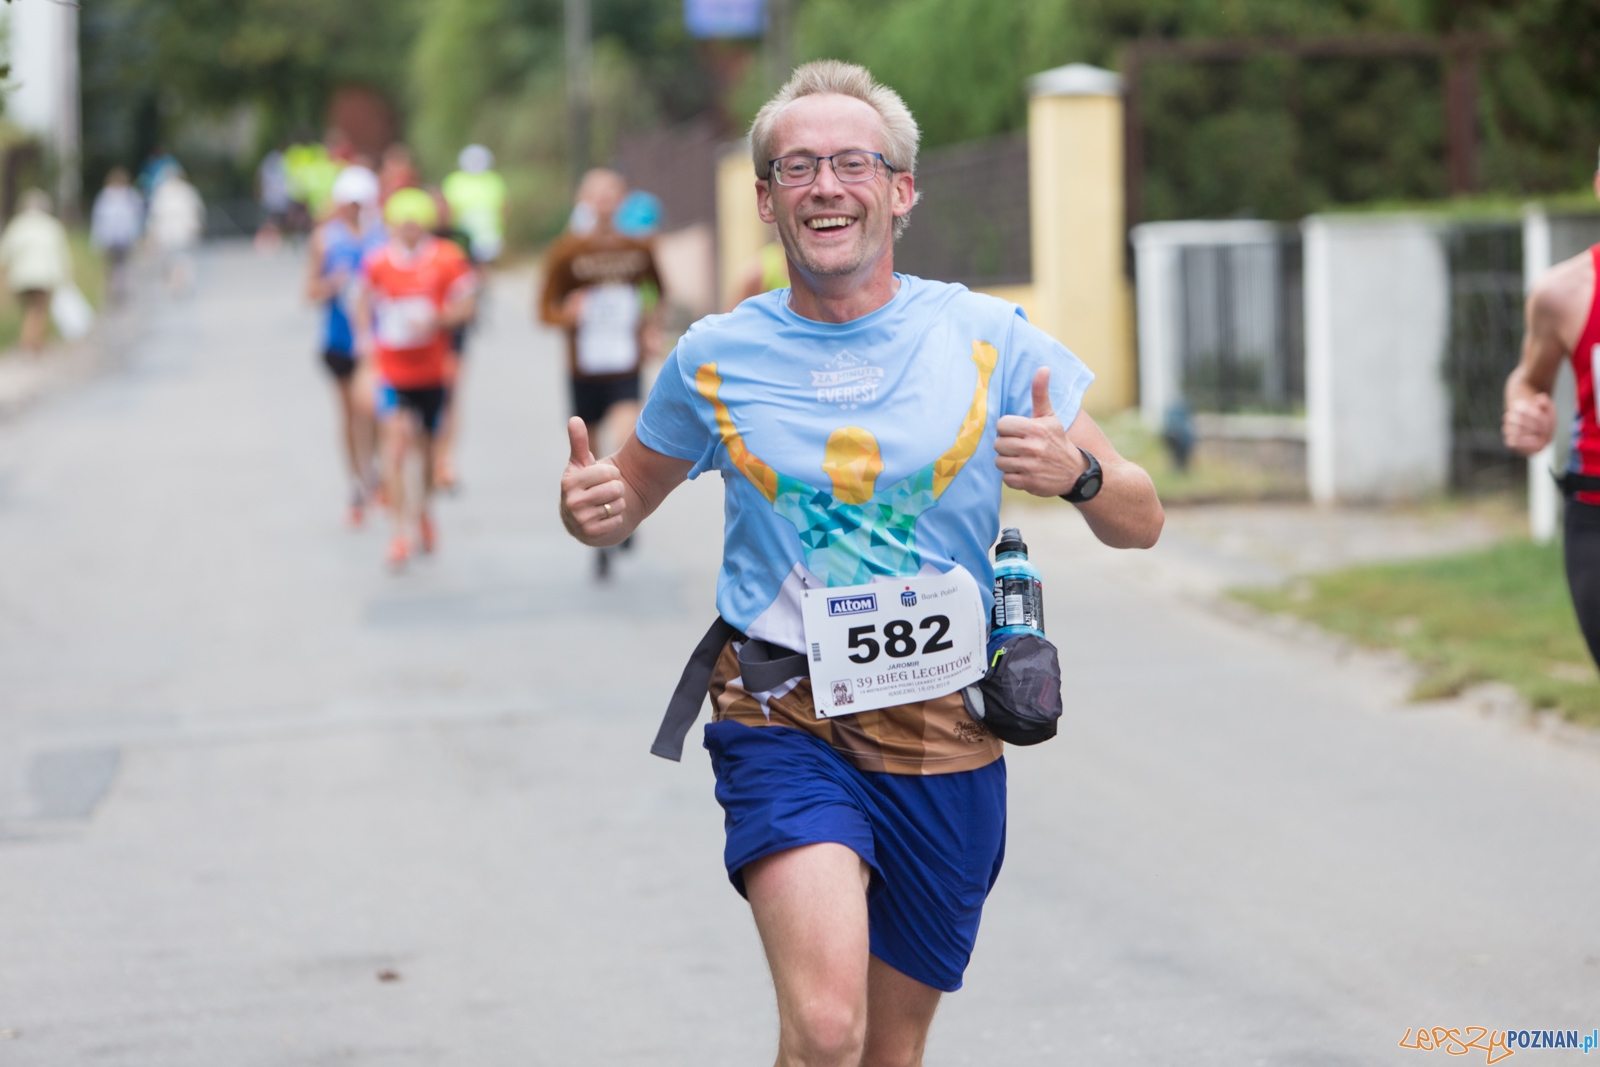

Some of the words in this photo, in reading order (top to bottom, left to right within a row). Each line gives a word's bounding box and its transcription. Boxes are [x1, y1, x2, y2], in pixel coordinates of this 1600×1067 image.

[817, 373, 832, 383] ZA
[817, 384, 879, 402] EVEREST
[921, 592, 938, 601] Bank
[941, 585, 958, 597] Polski
[848, 614, 953, 664] 582
[857, 676, 873, 688] 39
[877, 670, 908, 685] BIEG
[912, 651, 973, 679] LECHITÓW
[887, 660, 920, 671] JAROMIR
